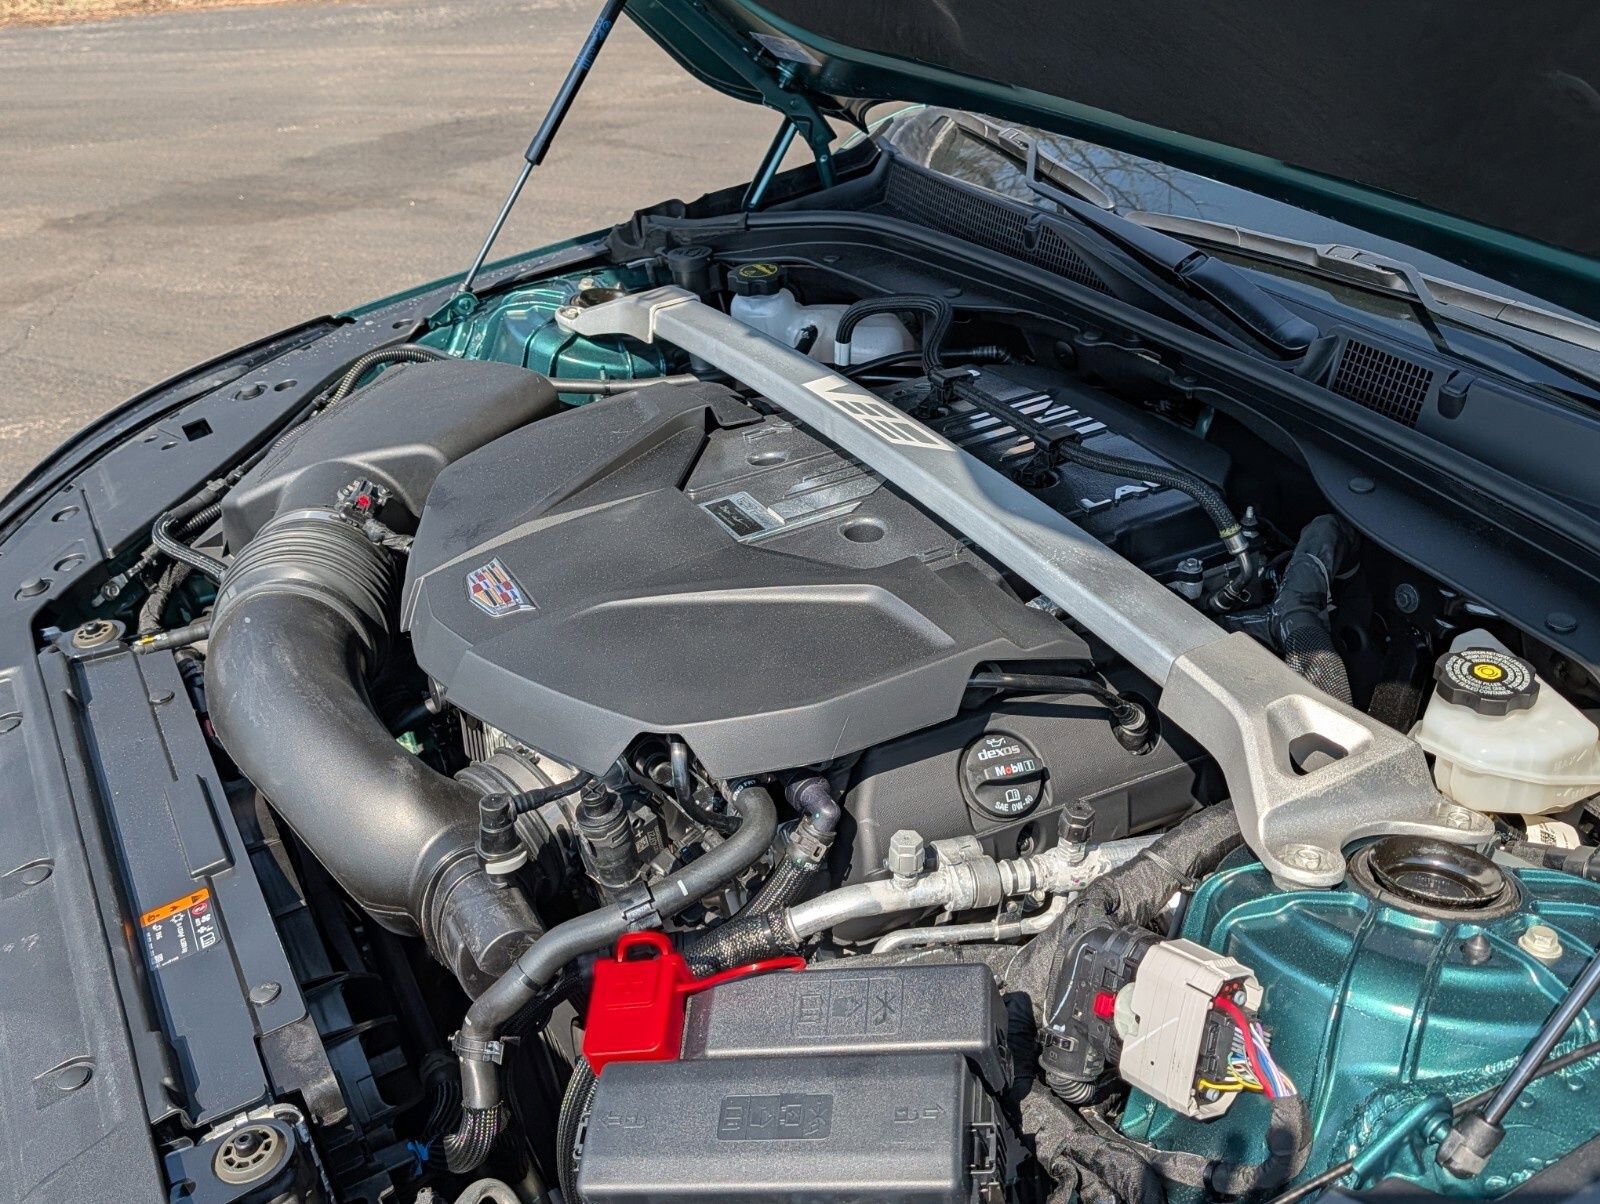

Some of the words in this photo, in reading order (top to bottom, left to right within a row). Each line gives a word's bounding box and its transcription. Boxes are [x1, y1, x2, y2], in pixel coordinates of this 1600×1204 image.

[978, 745, 1021, 761] dexos
[995, 763, 1024, 777] Mobil
[995, 801, 1009, 812] SAE
